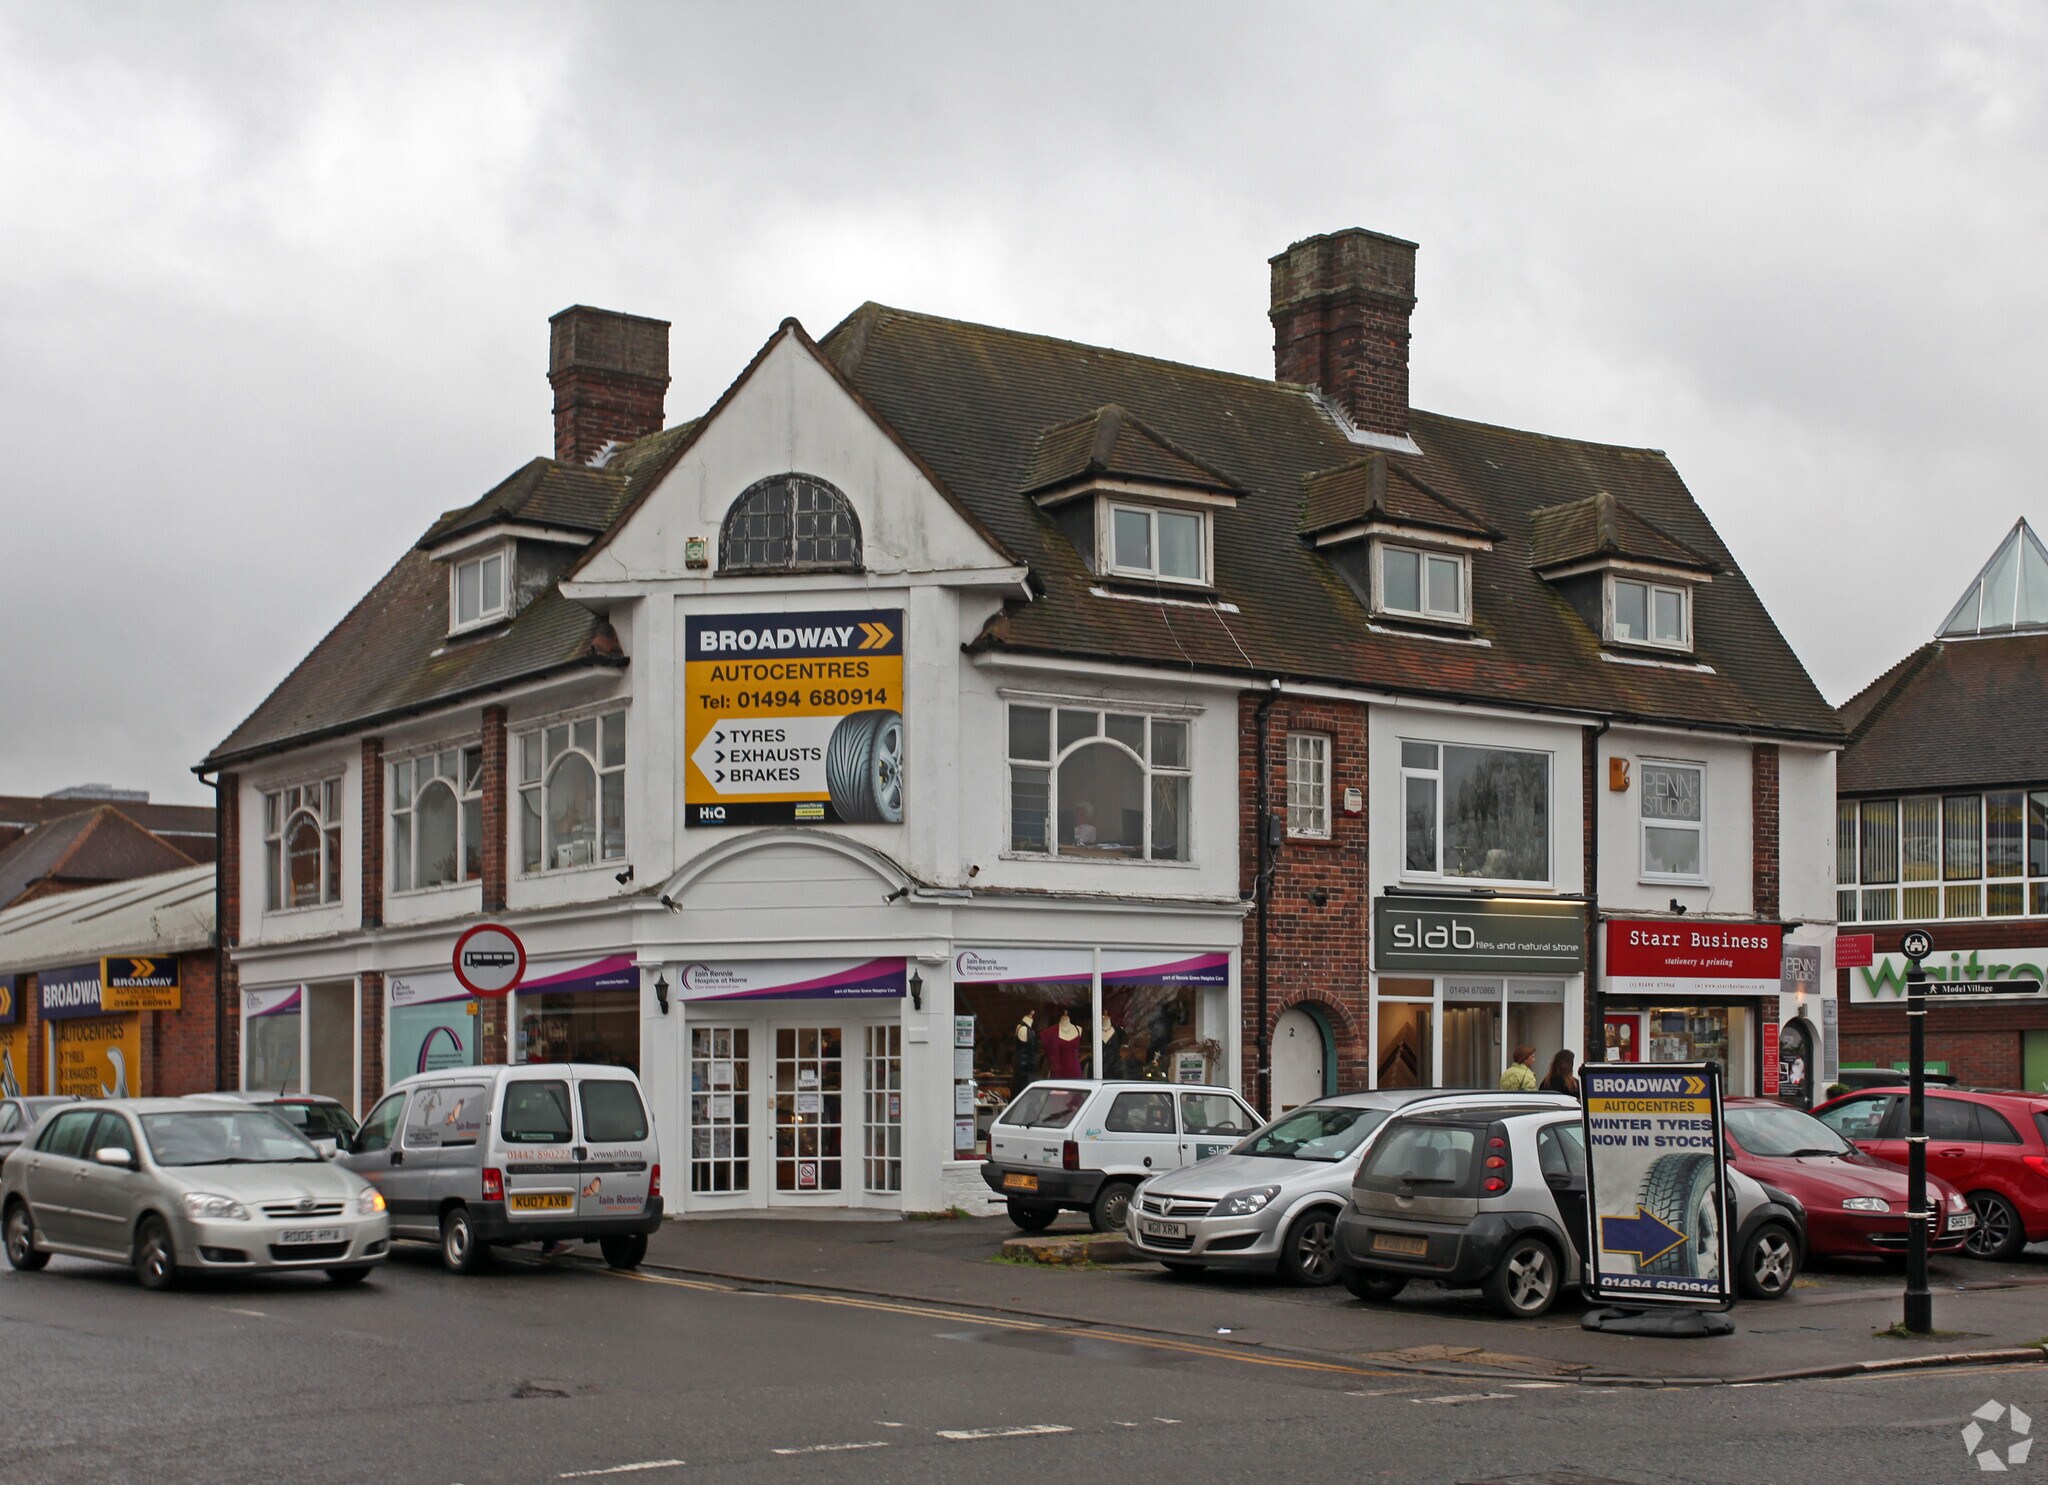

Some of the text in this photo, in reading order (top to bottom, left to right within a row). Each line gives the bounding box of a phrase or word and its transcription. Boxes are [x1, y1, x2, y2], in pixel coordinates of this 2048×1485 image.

[700, 626, 855, 652] BROADWAY
[710, 661, 870, 682] AUTOCENTRES
[700, 688, 888, 709] Tel: 01494 680914
[730, 729, 786, 743] TYRES
[730, 748, 822, 763] EXHAUSTS
[730, 768, 800, 782] BRAKES
[1643, 771, 1693, 798] PENN
[700, 806, 726, 819] HiQ
[1643, 796, 1693, 817] STUDIO
[1393, 918, 1475, 949] slab
[1630, 930, 1769, 949] Starr Business
[1476, 940, 1579, 952] tiles and natural stone
[1665, 957, 1698, 967] stationery
[1706, 958, 1733, 968] printing
[1786, 957, 1814, 972] PENN
[695, 969, 733, 978] Iain Rennie
[1786, 970, 1814, 982] STUDIO
[113, 977, 172, 987] BROADWAY
[695, 977, 719, 985] Hospice
[1449, 985, 1470, 995] 01494
[1942, 984, 1993, 994] Model Village
[61, 1023, 124, 1042] AUTOCENTRES
[1289, 1027, 1295, 1038] 2
[65, 1052, 85, 1064] TYRES
[65, 1067, 98, 1081] EXHAUSTS
[65, 1084, 98, 1096] BATTERIES
[1592, 1078, 1682, 1093] BROADWAY
[1604, 1100, 1695, 1112] AUTOCENTRES
[1590, 1118, 1713, 1131] WINTER TYRES
[1591, 1134, 1714, 1148] NOW IN STOCK
[507, 1148, 571, 1160] 01442 890222
[593, 1149, 643, 1160] www.irhh.org
[516, 1194, 568, 1208] KU07 AXB
[599, 1194, 644, 1205] Iain Rennie
[1162, 1223, 1179, 1236] XRM
[1601, 1277, 1719, 1293] 01494 680914
